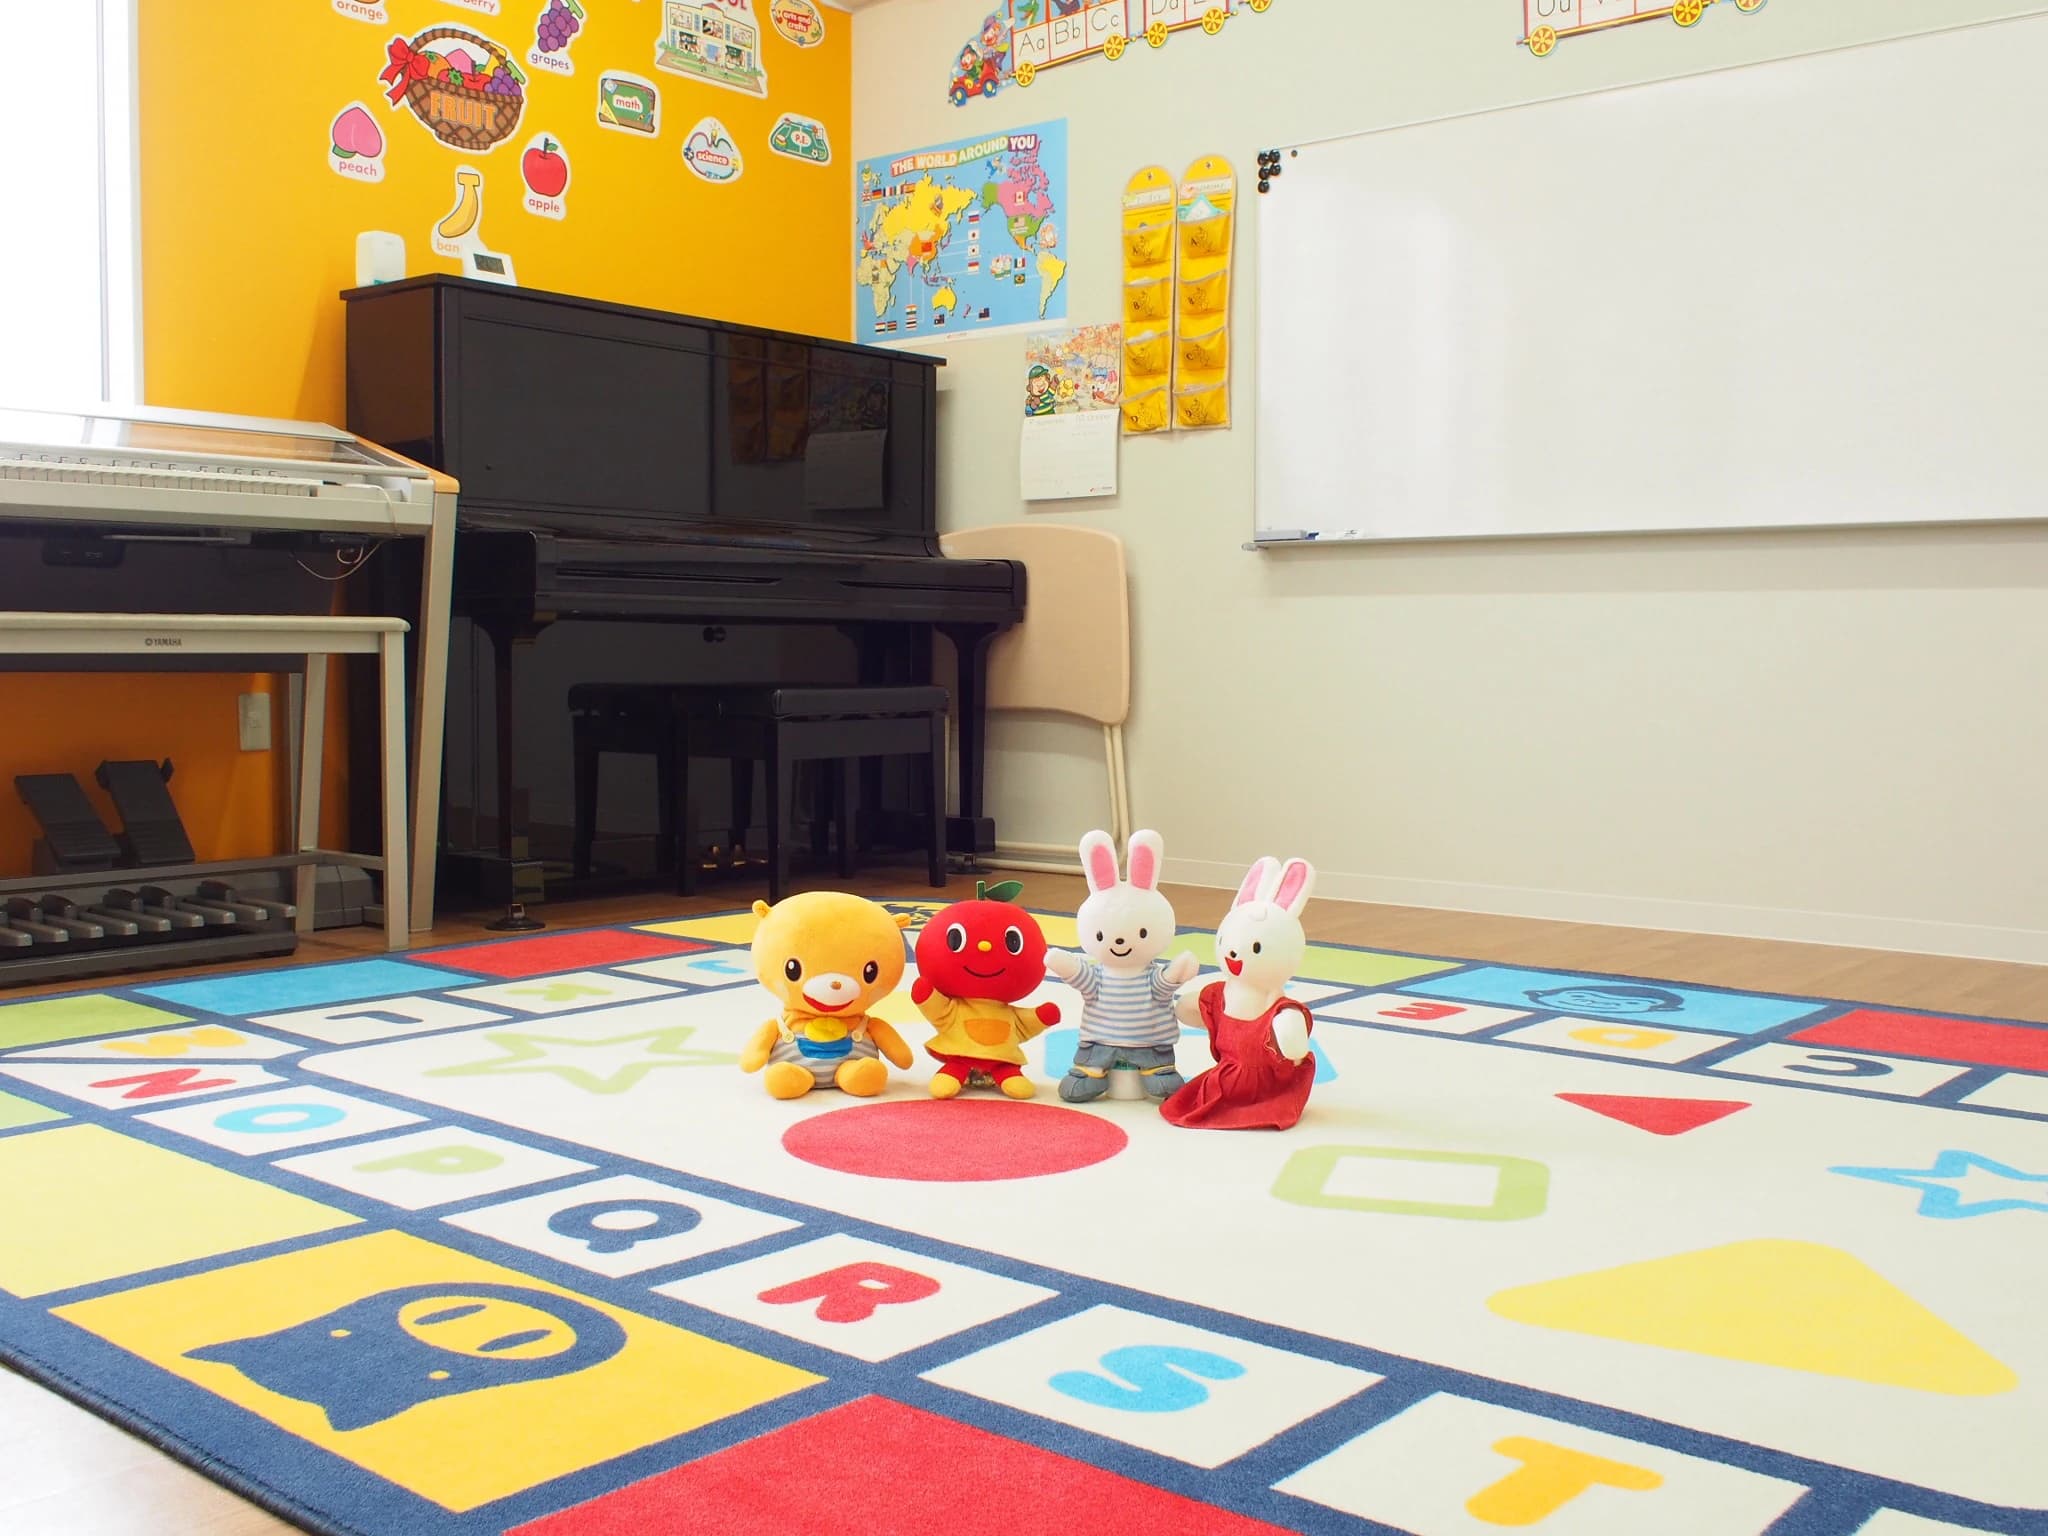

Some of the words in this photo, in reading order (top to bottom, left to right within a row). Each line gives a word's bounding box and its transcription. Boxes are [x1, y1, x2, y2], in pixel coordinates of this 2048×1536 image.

[336, 1, 384, 21] orange
[1091, 7, 1120, 31] Cc
[1018, 32, 1045, 57] Aa
[1054, 18, 1081, 45] Bb
[530, 51, 570, 71] grapes
[430, 90, 497, 130] FRUIT
[615, 97, 641, 111] math
[338, 158, 378, 177] peach
[696, 151, 729, 165] science
[891, 157, 914, 176] THE
[915, 152, 957, 169] WORLD
[958, 136, 1008, 163] AROUND
[1009, 135, 1036, 150] YOU
[528, 197, 561, 214] apple
[154, 638, 183, 647] YAMAHA
[100, 1022, 247, 1057] M
[88, 1067, 237, 1099] N
[212, 1102, 348, 1134] O
[351, 1144, 505, 1176] P
[546, 1198, 703, 1254] Q
[756, 1261, 942, 1323] R
[1048, 1344, 1248, 1413] S
[1464, 1435, 1665, 1527] T
